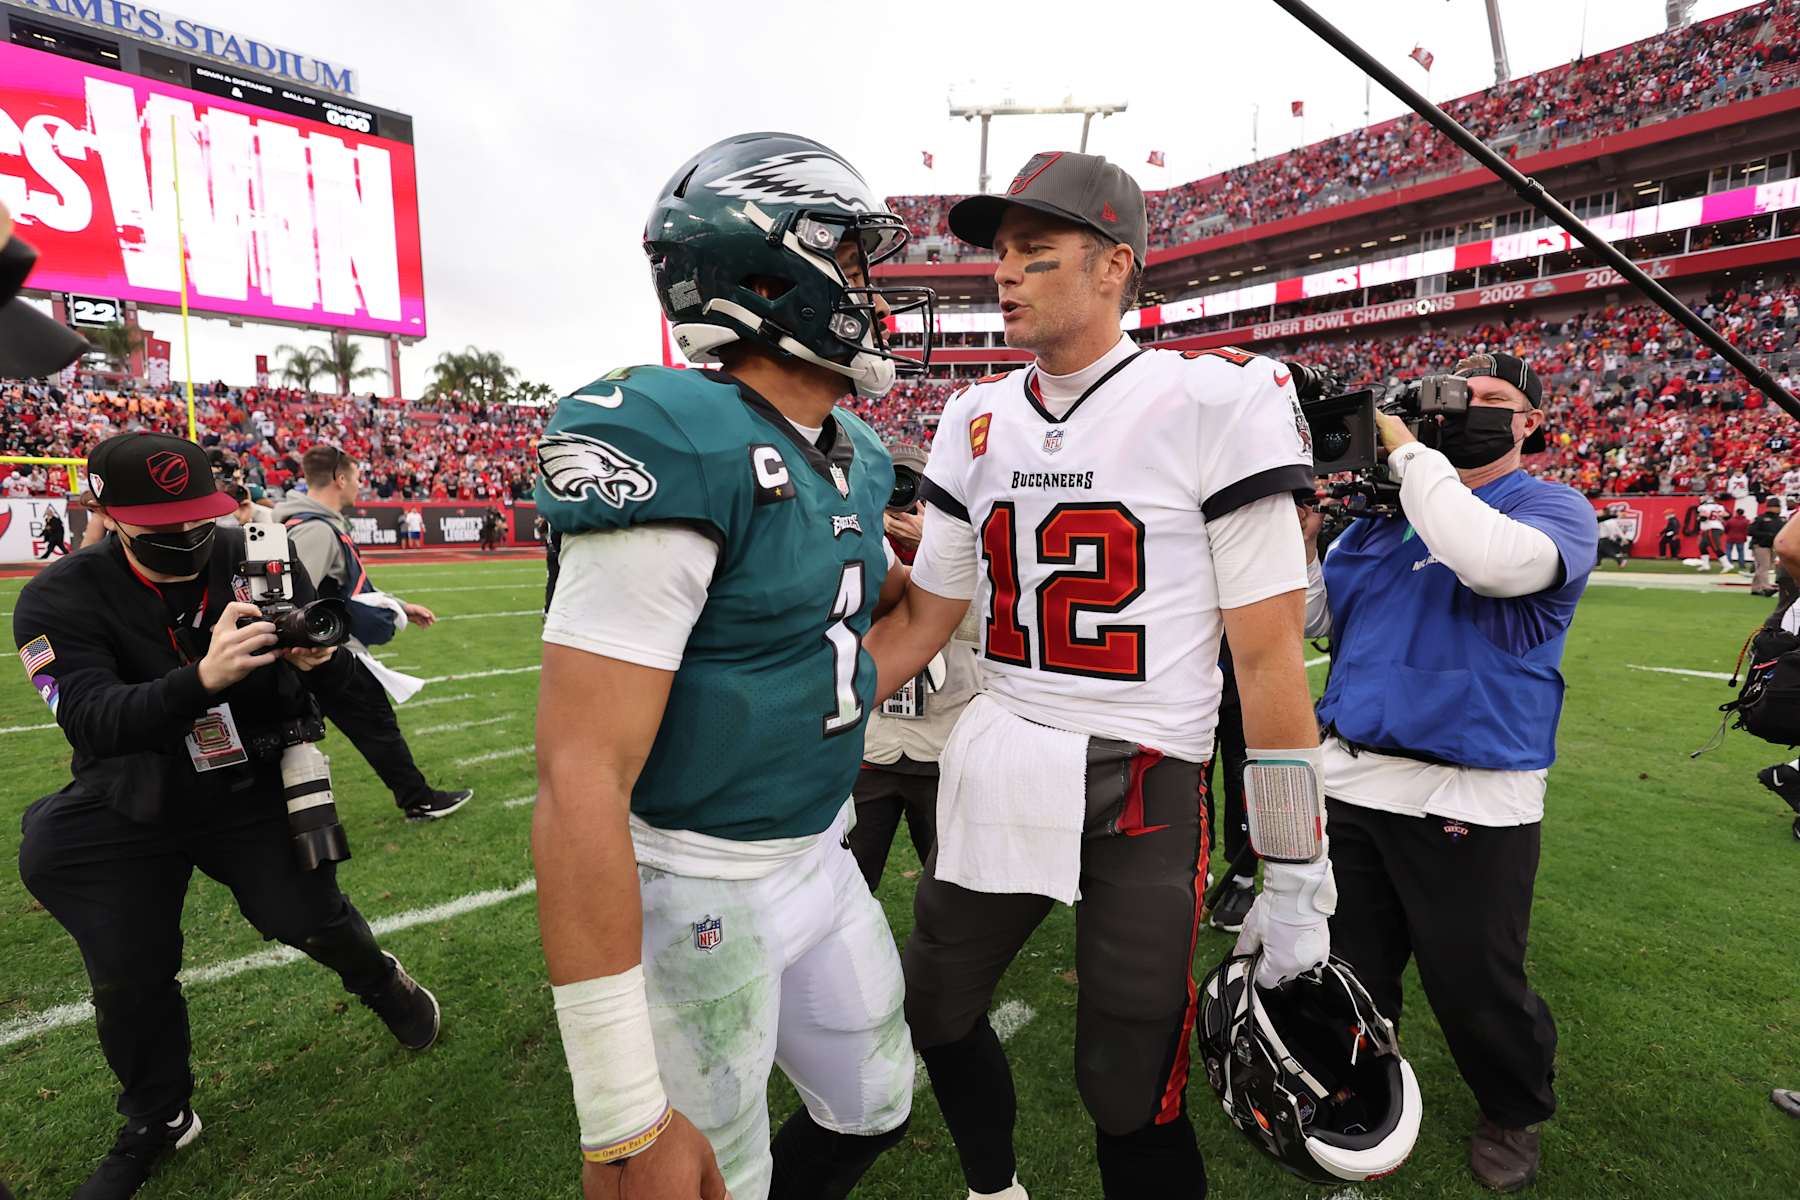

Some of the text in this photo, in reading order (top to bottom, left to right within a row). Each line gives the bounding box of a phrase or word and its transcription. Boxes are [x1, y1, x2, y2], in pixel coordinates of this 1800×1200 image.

[174, 19, 353, 94] STADIUM
[326, 109, 370, 133] 0:00
[74, 301, 116, 322] 22
[1253, 321, 1300, 340] SUPER
[1304, 314, 1350, 331] BOWL
[1352, 296, 1455, 324] CHAMPIONS
[1480, 285, 1525, 305] 2002
[1584, 270, 1629, 289] 202
[1045, 438, 1060, 449] NFL
[753, 446, 788, 490] C
[981, 500, 1146, 681] 12
[823, 560, 865, 740] 1
[700, 930, 720, 945] NFL
[602, 1146, 626, 1158] Omega
